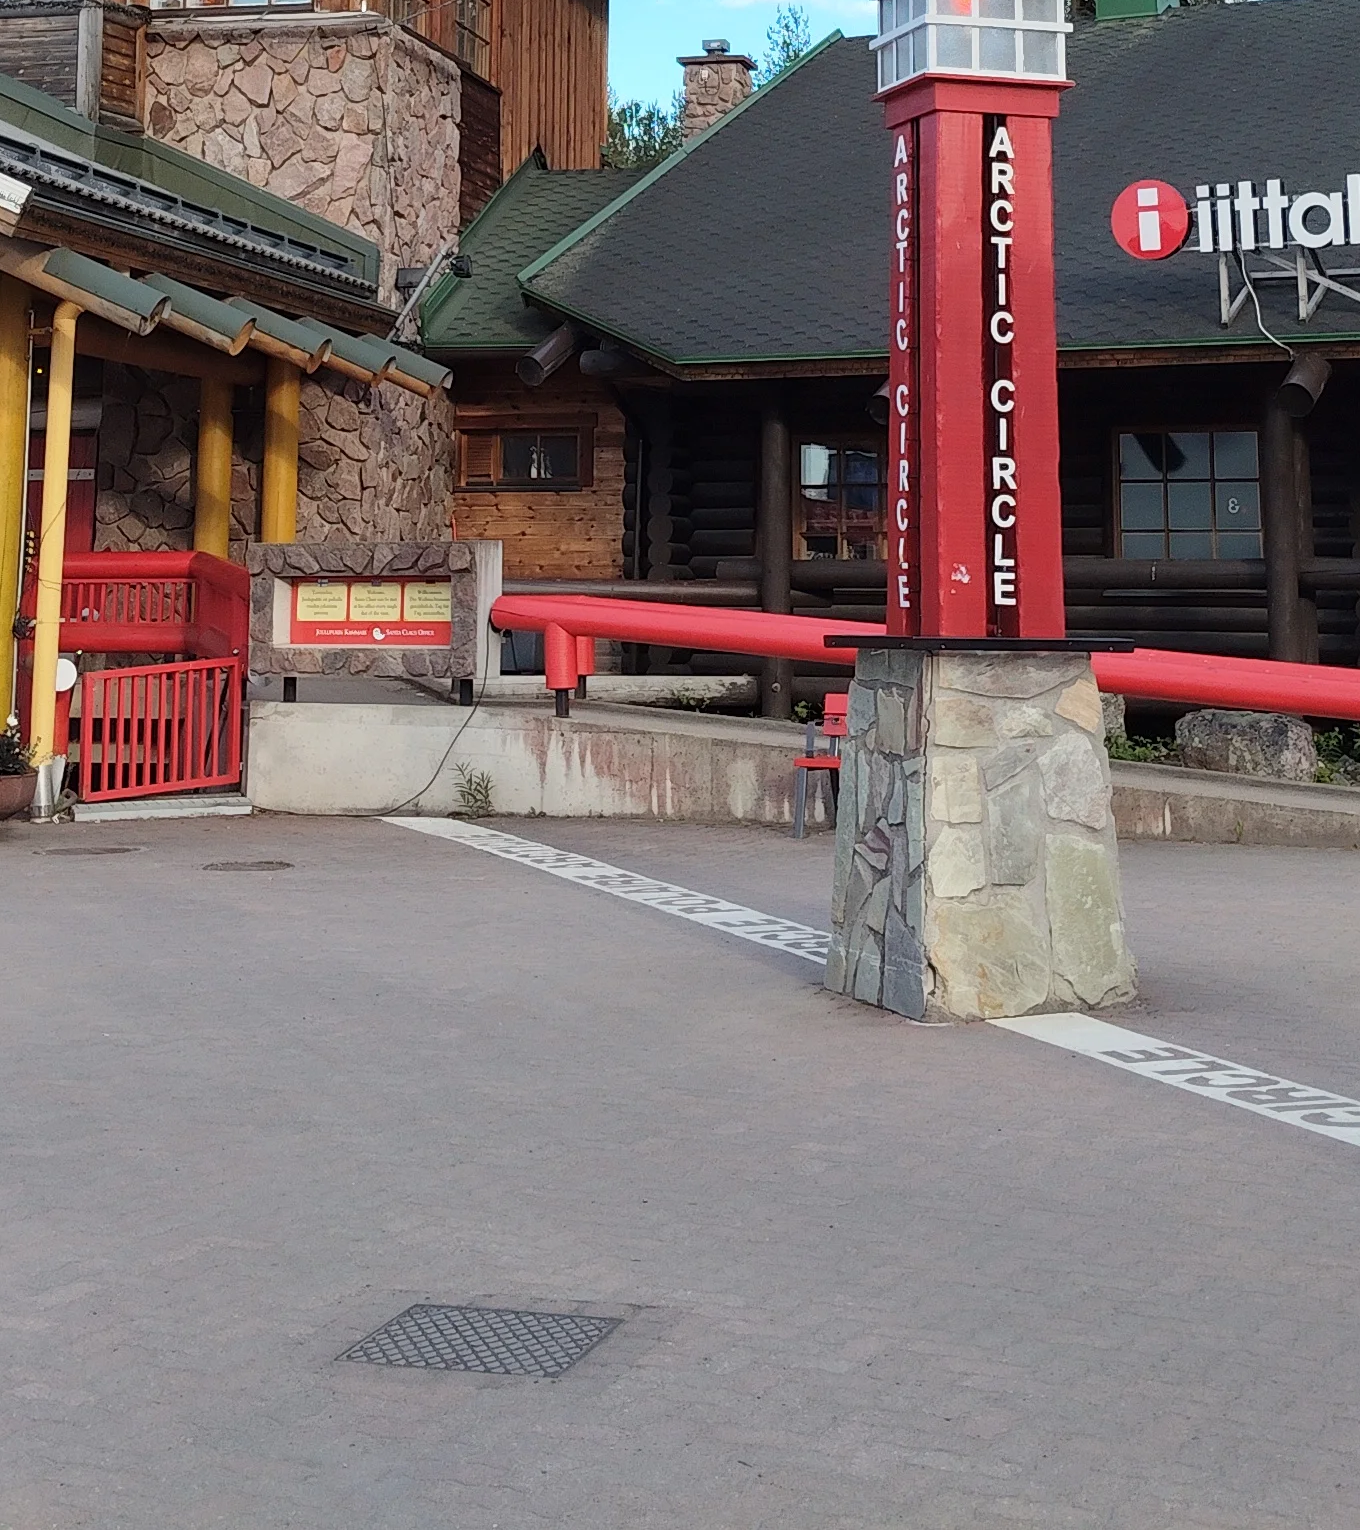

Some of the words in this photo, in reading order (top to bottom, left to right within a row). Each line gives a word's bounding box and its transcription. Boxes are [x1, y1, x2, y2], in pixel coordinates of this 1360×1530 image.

[893, 133, 911, 353] ARCTIC
[988, 125, 1016, 345] ARCTIC
[1137, 187, 1162, 252] i
[895, 383, 912, 609] CIRCLE
[990, 378, 1018, 607] CIRCLE
